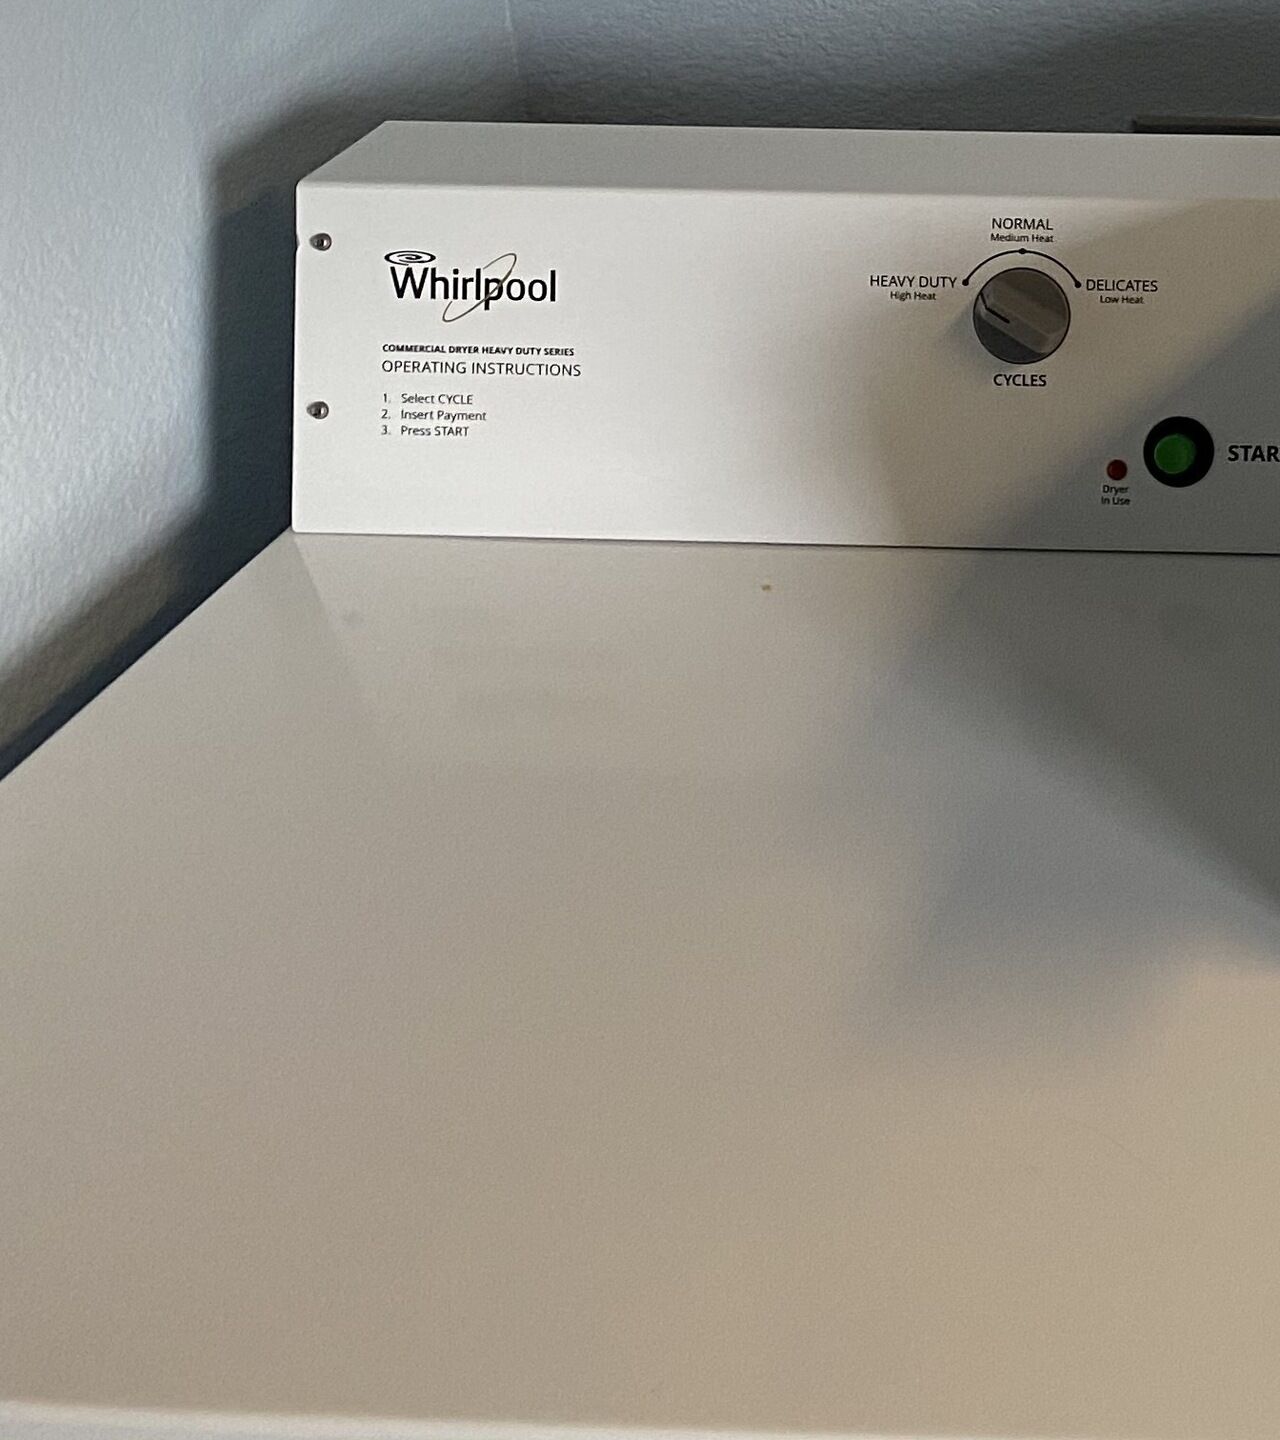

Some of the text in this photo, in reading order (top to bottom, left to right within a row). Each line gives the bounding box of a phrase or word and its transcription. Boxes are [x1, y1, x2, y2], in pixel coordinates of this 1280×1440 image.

[991, 217, 1054, 231] NORMAL
[990, 232, 1054, 243] Medium Heat
[869, 274, 957, 289] HEAVY DUTY
[1085, 279, 1159, 293] DELICATES
[389, 266, 557, 311] Whirlpool
[890, 291, 936, 302] High Heat
[1100, 295, 1144, 305] Low Heat
[382, 344, 575, 357] COMMERCIAL DRYER HEAVY DUTY SERIES
[381, 360, 581, 377] OPERATING INSTRUCTIONS
[993, 373, 1047, 387] CYCLES
[383, 393, 474, 405] 1. Select CYCLE
[381, 409, 487, 425] 2. Insert Payment
[381, 425, 469, 437] 3. Press START
[1102, 484, 1129, 496] Dryer
[1101, 496, 1130, 506] In Use
